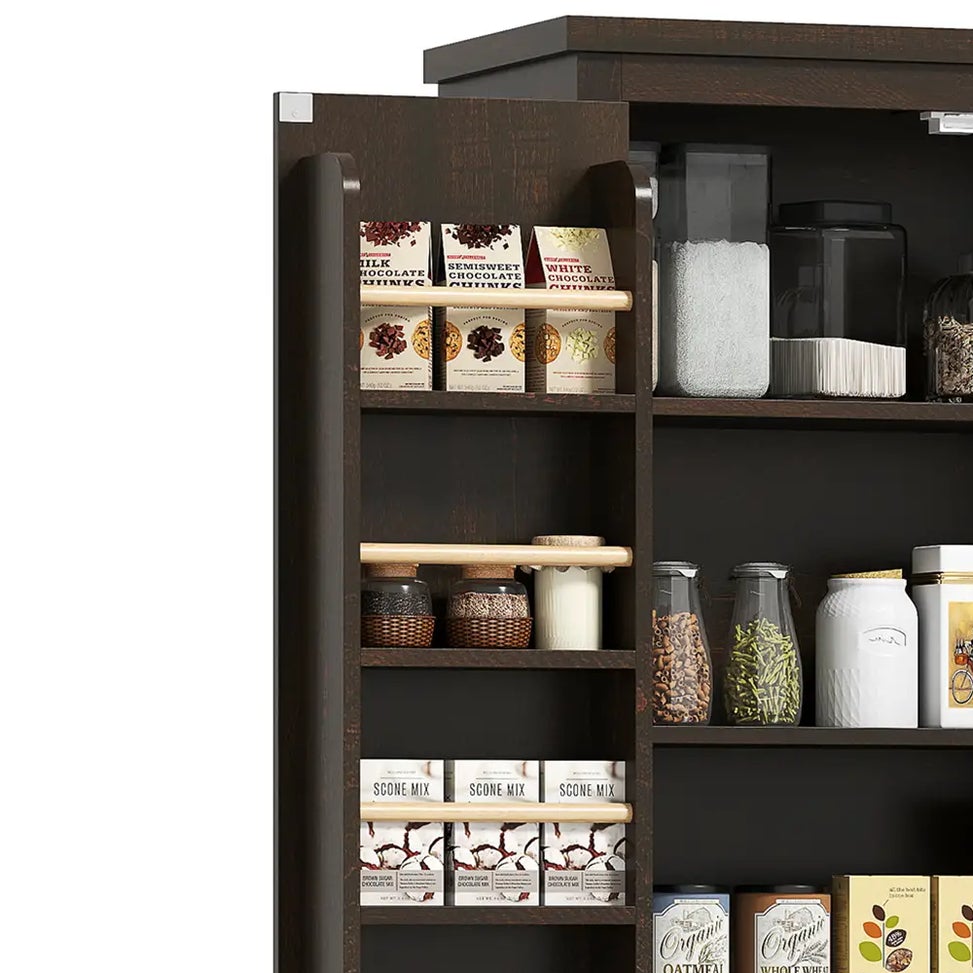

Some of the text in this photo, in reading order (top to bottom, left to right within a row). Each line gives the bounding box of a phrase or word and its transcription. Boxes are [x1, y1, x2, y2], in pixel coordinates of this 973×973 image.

[448, 262, 520, 271] SEMISWEET
[545, 264, 592, 274] WHITE
[360, 269, 425, 277] HOCOLATE
[448, 272, 522, 280] CHOCOLATE
[548, 274, 615, 284] CHOCOLATE
[373, 782, 430, 797] SCONE MIX
[469, 783, 525, 797] SCONE MIX
[559, 783, 615, 797] SCONE MIX
[660, 914, 723, 962] Organic
[761, 914, 826, 962] Organic
